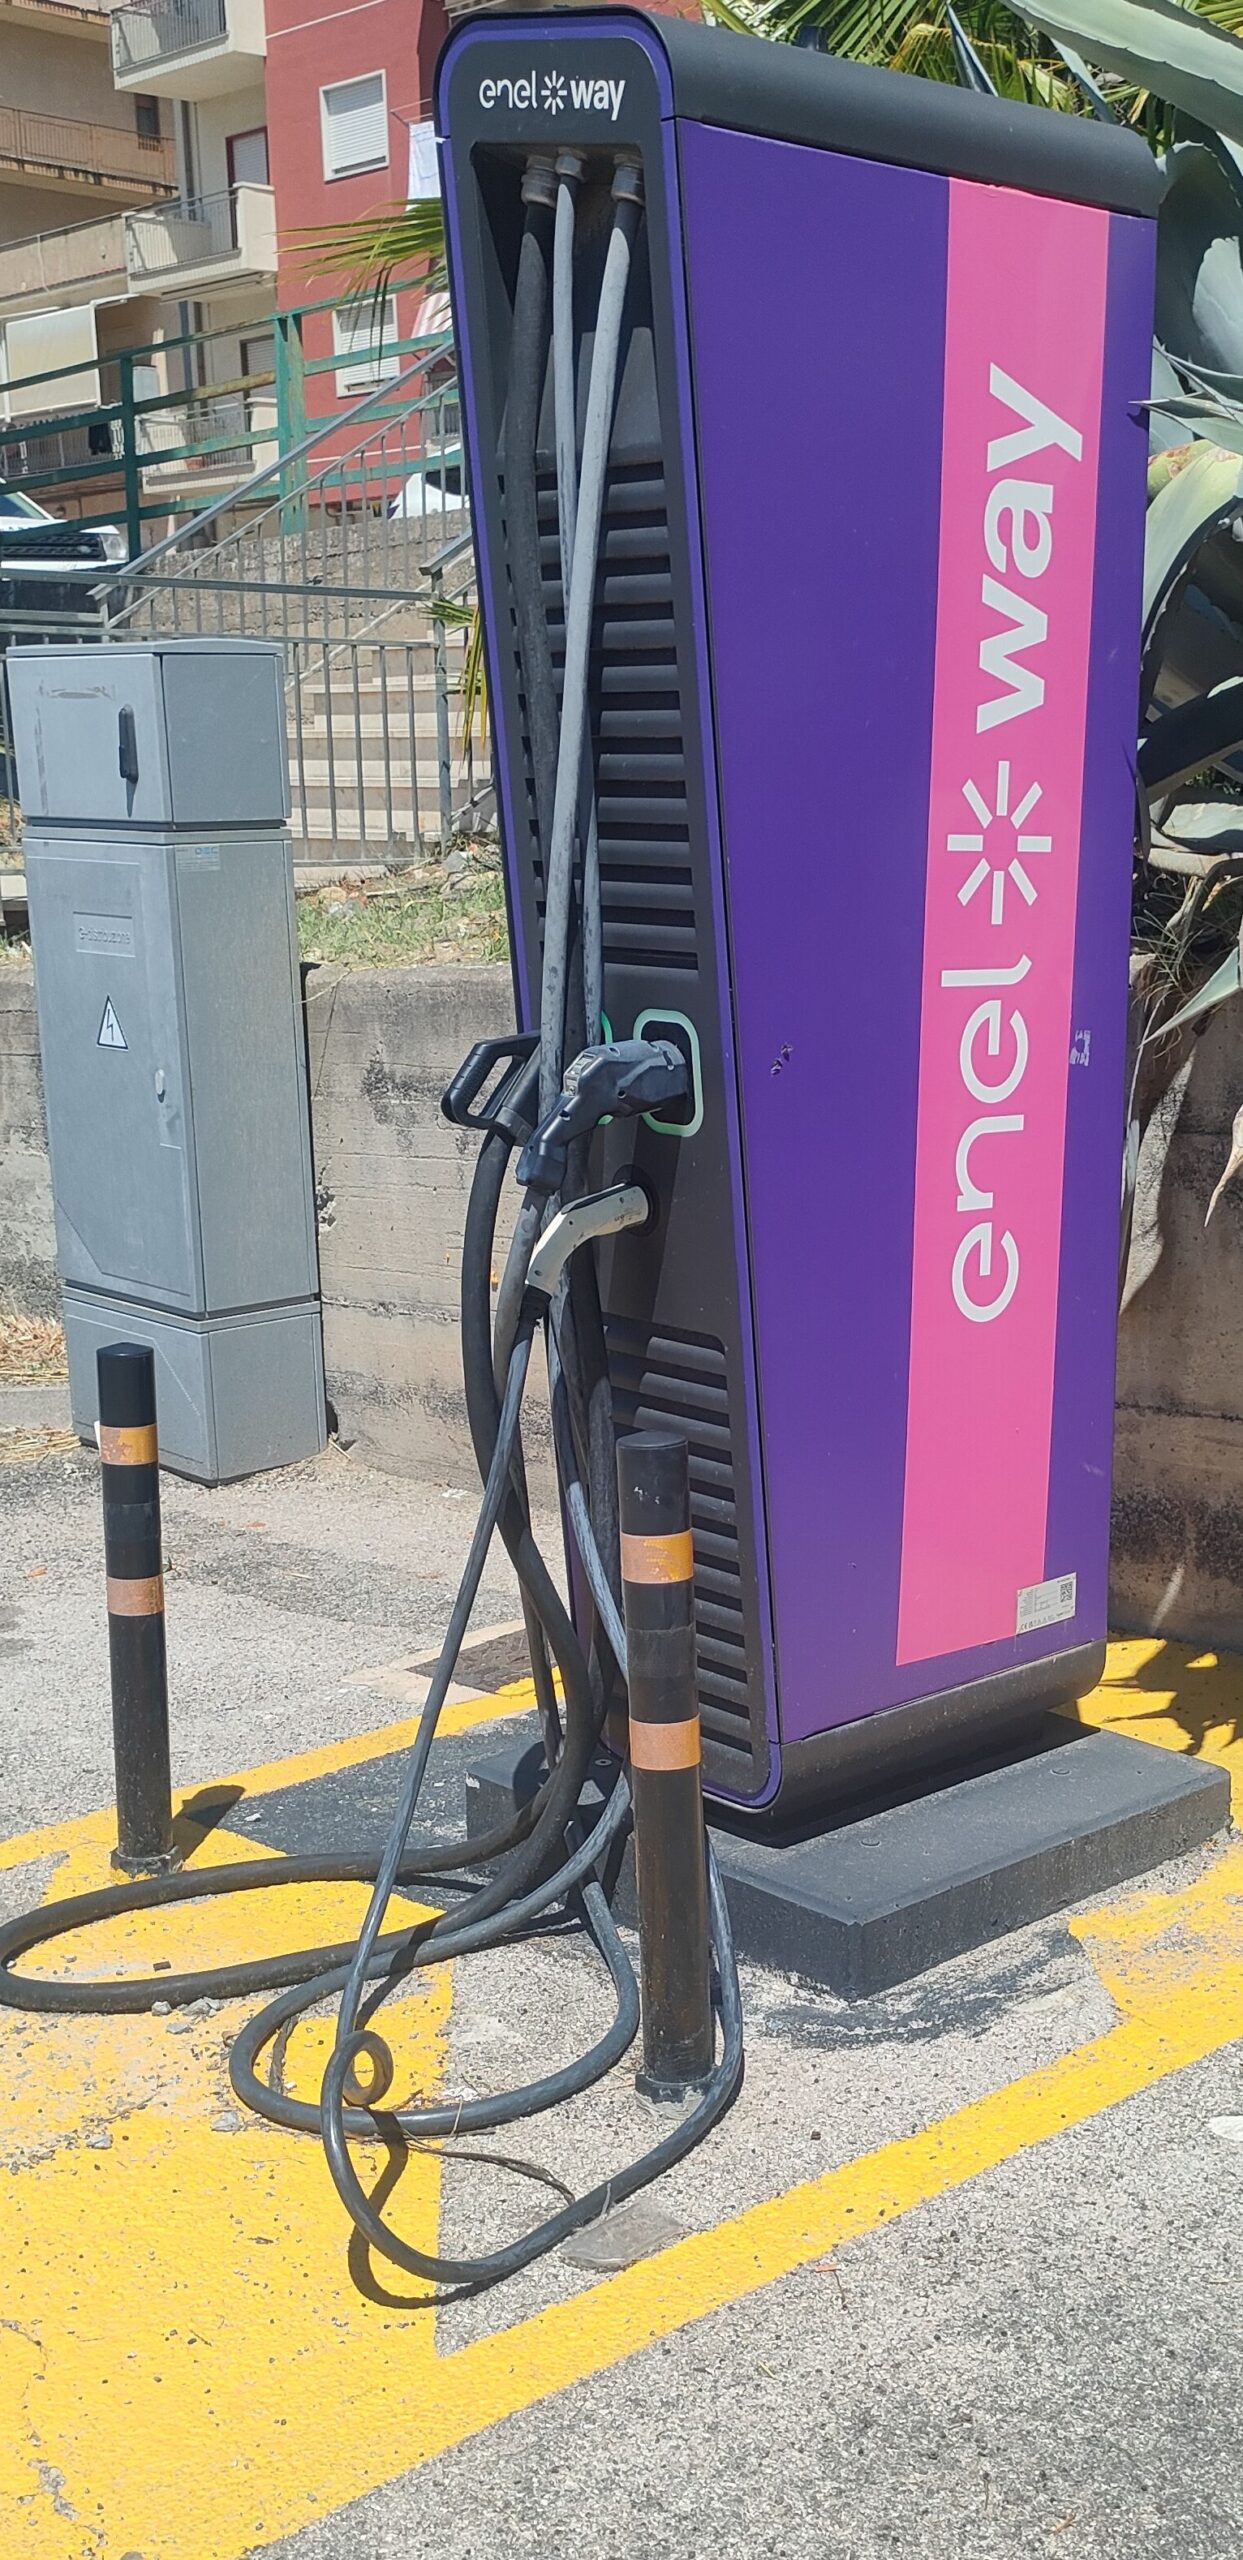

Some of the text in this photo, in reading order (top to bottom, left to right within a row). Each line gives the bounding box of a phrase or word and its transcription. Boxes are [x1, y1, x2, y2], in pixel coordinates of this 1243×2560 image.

[479, 70, 626, 121] enel way
[941, 362, 1083, 1323] enel way
